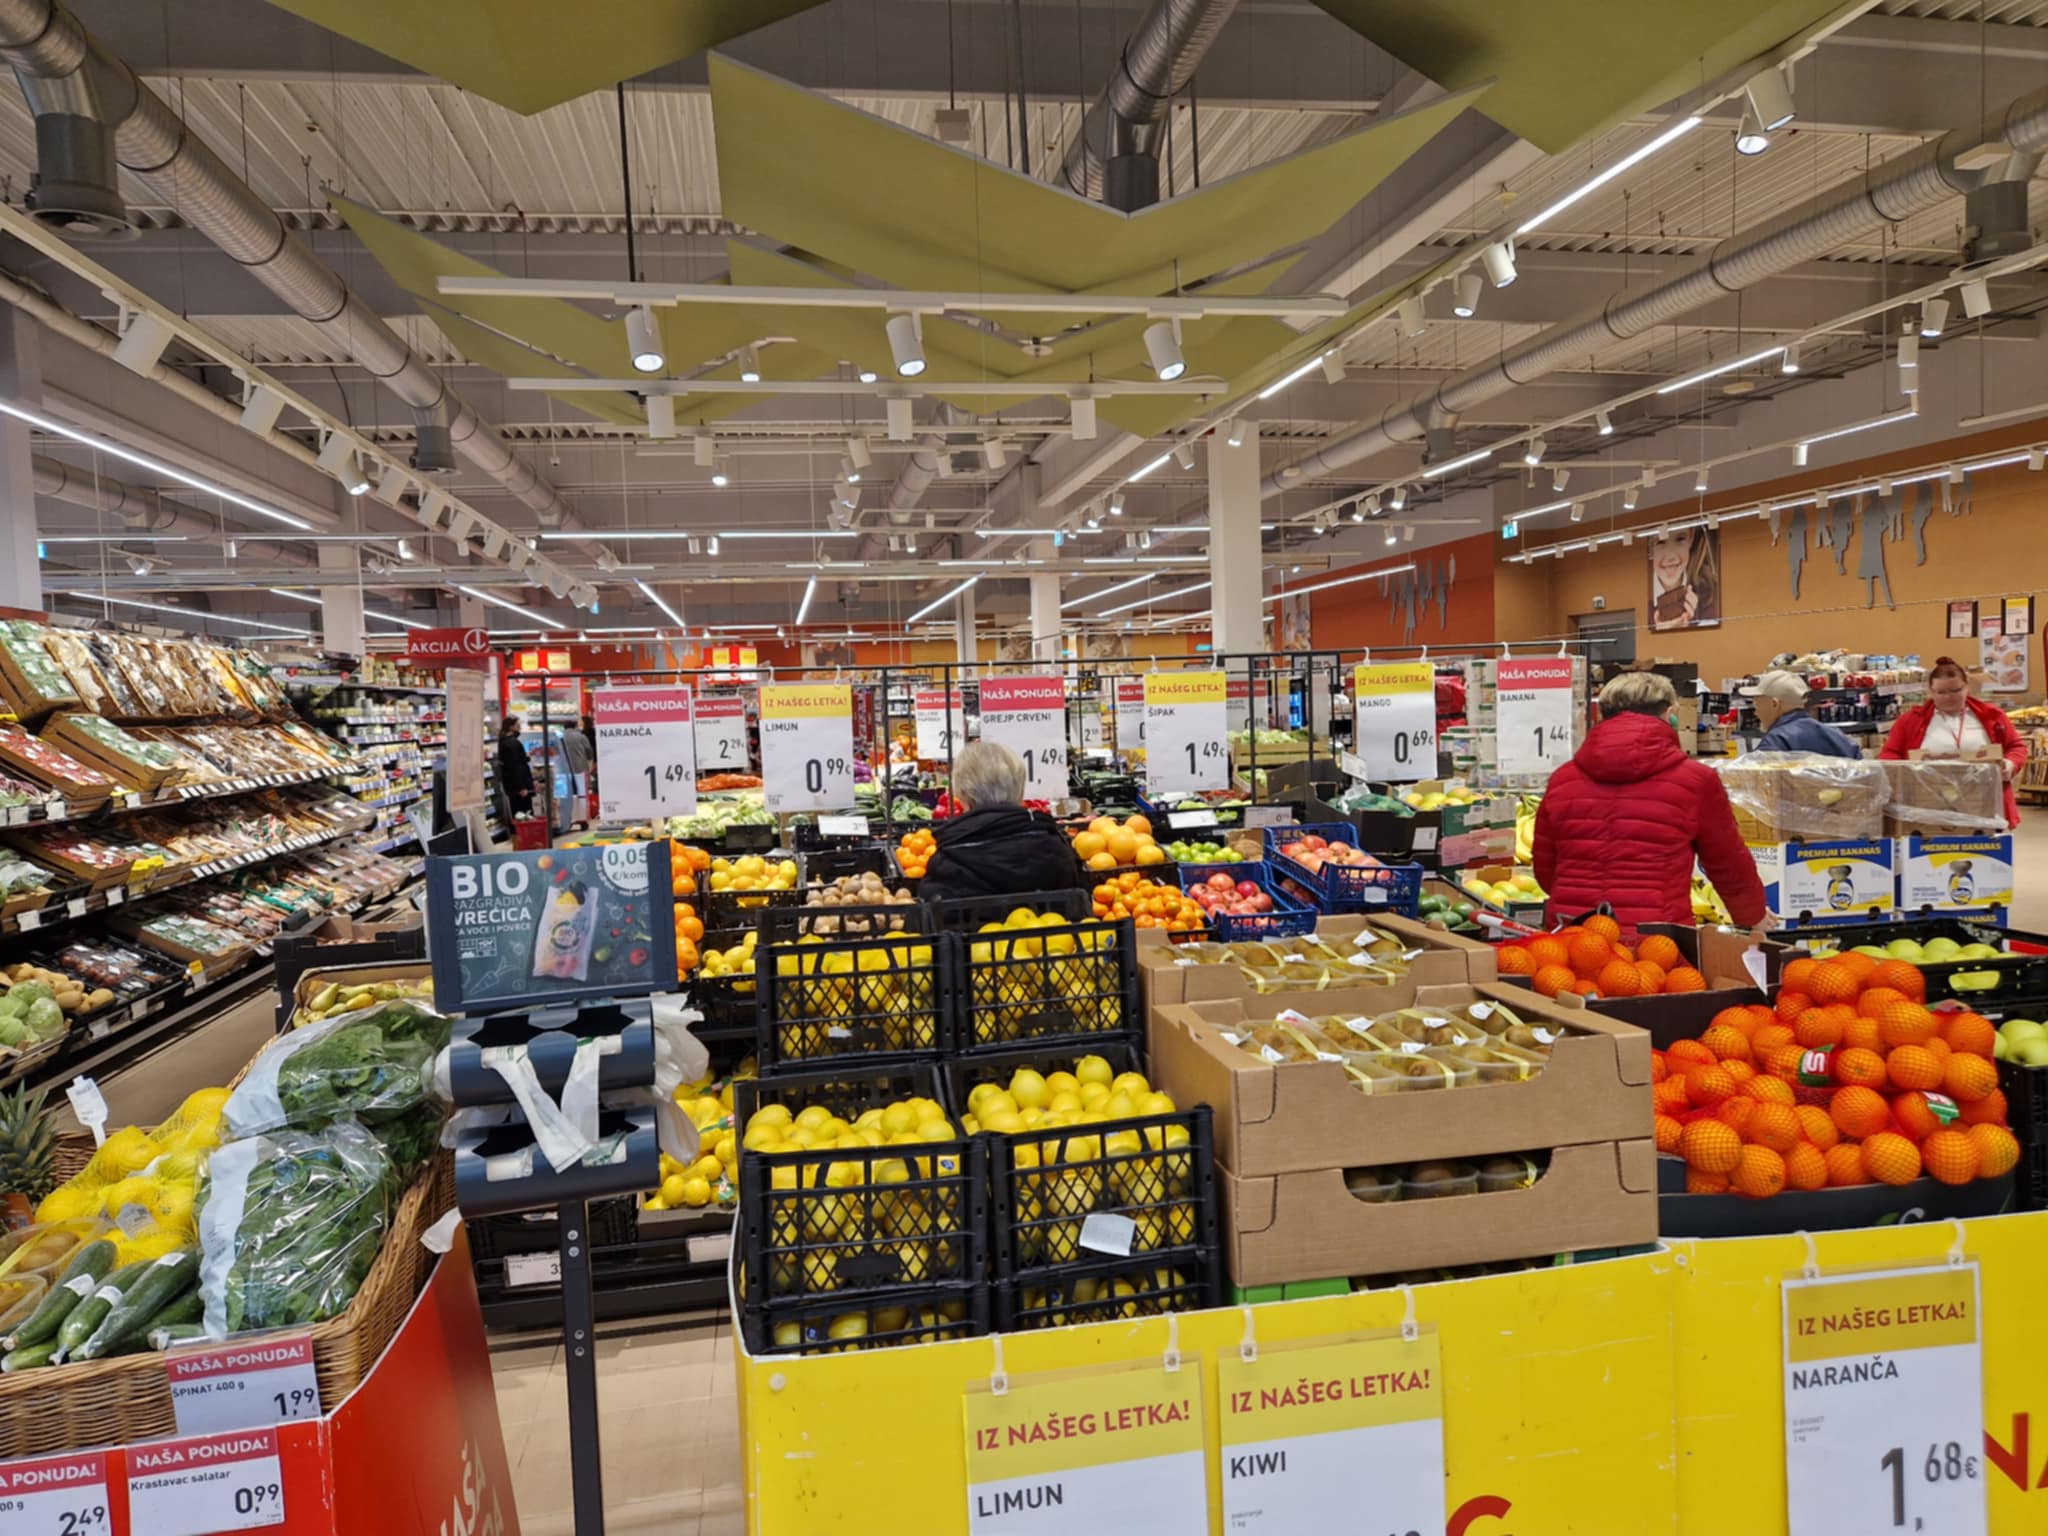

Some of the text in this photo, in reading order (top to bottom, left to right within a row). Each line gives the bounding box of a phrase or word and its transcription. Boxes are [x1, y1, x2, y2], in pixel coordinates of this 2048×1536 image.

[410, 641, 461, 653] AKCIJA
[1368, 675, 1398, 685] NAŠEG
[1499, 668, 1570, 680] NAŠA PONUDA!
[982, 688, 1062, 700] NAŠA PONUDA!
[1148, 685, 1157, 694] IZ
[1159, 684, 1190, 693] NAŠEG
[1192, 683, 1222, 693] LETKA!
[765, 697, 848, 707] IZ NAŠEG LETKA!
[1359, 698, 1391, 708] MANGO
[1500, 693, 1536, 702] BANANA
[598, 700, 688, 713] NAŠA PONUDA!
[1148, 707, 1175, 717] ŠIPAK
[983, 712, 1052, 724] GREJP CRVENI
[599, 725, 653, 738] NARANČA
[765, 722, 799, 732] LIMUN
[1796, 847, 1882, 859] PREMIUM BANANAS
[452, 861, 529, 900] BIO
[1798, 1301, 1966, 1336] IZ NAŠEG LETKA!
[176, 1344, 305, 1375] NAŠA PONUDA!
[1792, 1355, 1899, 1390] NARANČA
[172, 1380, 245, 1399] ŠPINAT 400 g
[1231, 1368, 1431, 1414] IZ NAŠEG LETKA!
[976, 1400, 1190, 1451] IZ NAŠEG LETKA!
[136, 1436, 270, 1469] NAŠA PONUDA!
[1230, 1450, 1288, 1479] KIWI
[12, 1463, 97, 1487] PONUDA!
[130, 1469, 231, 1491] Krastavac salatar
[17, 1501, 24, 1511] g
[977, 1483, 1064, 1518] LIMUN
